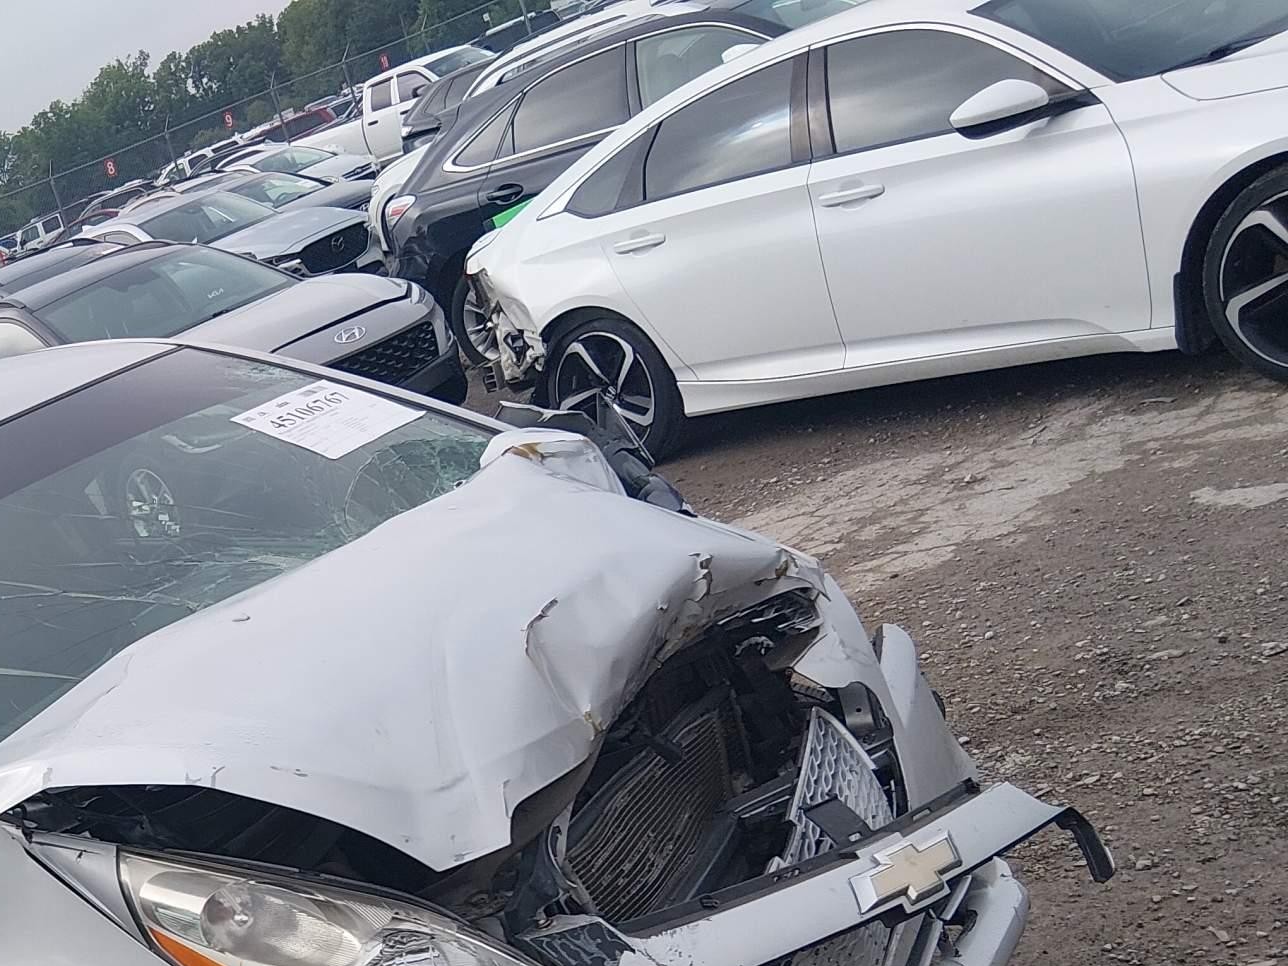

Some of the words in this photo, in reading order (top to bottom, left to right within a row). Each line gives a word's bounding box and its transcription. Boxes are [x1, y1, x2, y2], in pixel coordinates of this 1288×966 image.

[225, 114, 232, 127] 9
[107, 161, 115, 174] 8
[269, 391, 349, 430] 45106767
